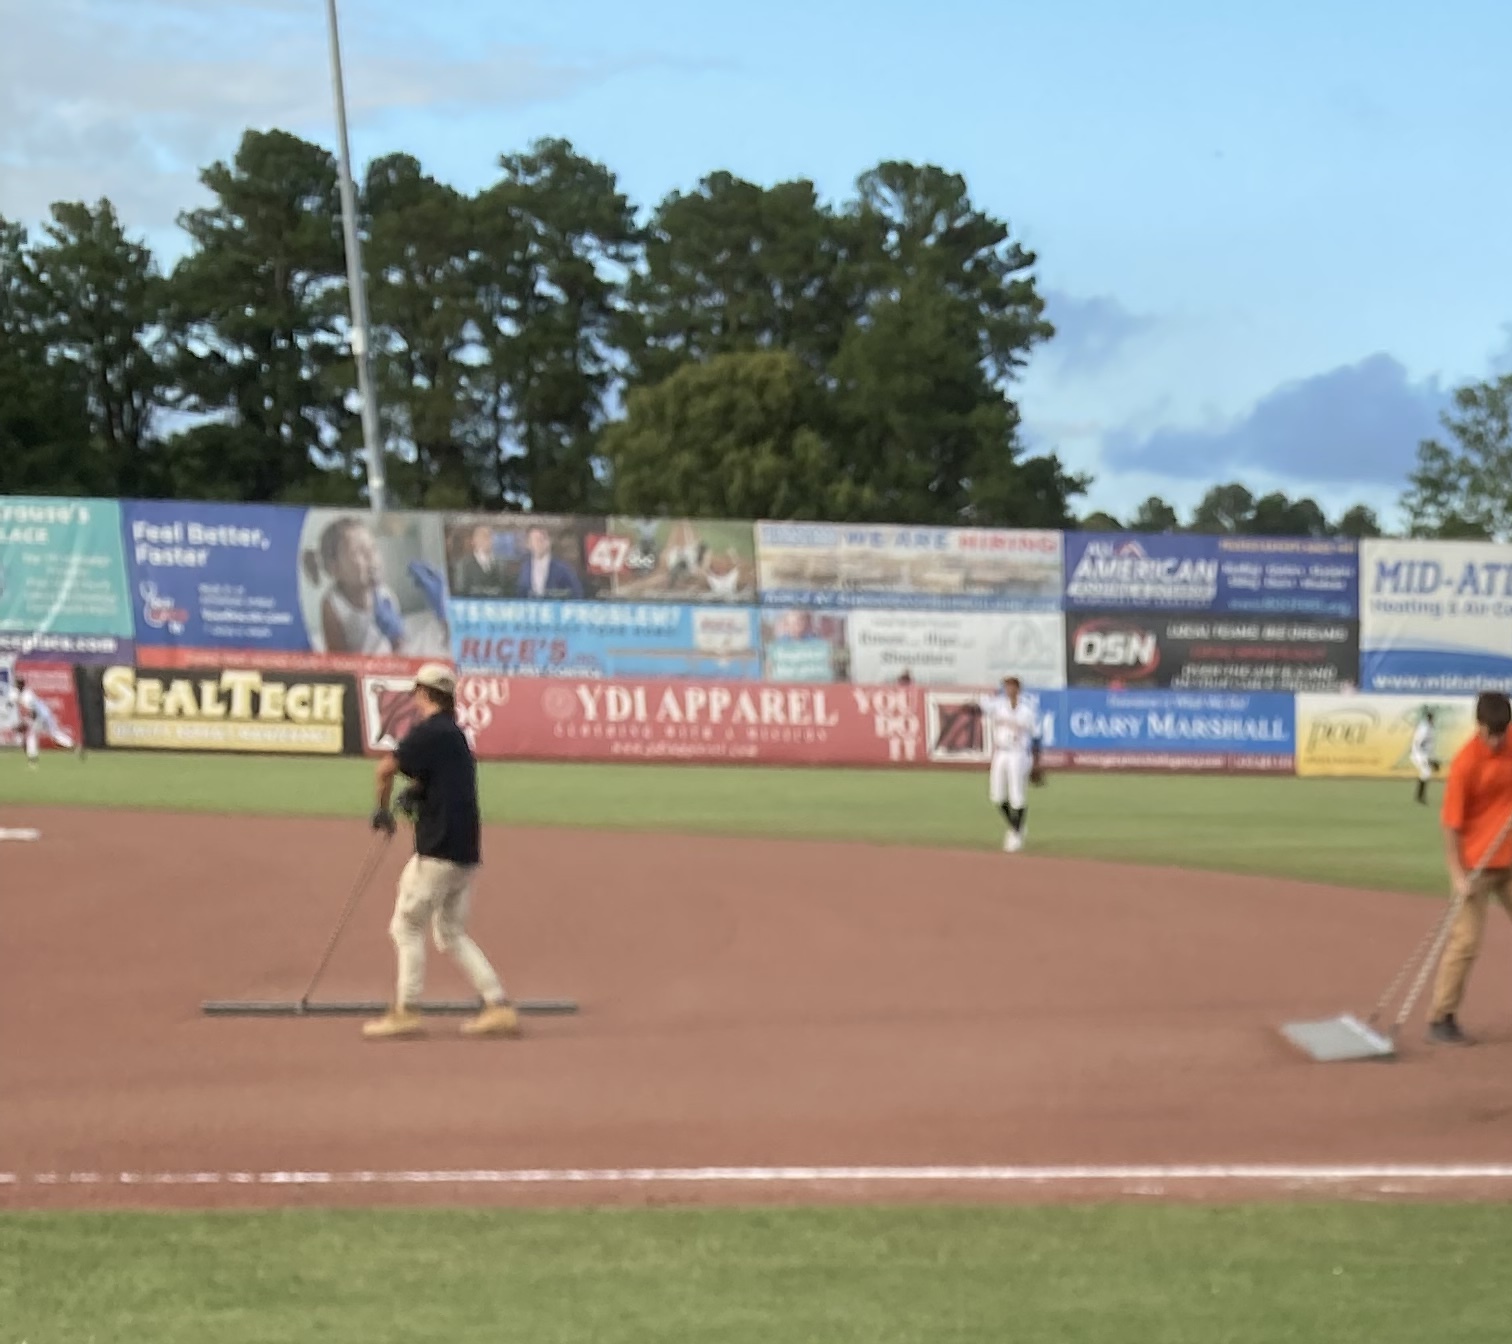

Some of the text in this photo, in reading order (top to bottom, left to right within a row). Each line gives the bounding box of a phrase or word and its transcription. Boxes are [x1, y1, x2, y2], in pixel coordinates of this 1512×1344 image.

[133, 520, 271, 550] Feel Better,
[957, 533, 1058, 554] HIRING
[135, 543, 210, 567] Faster
[588, 535, 630, 573] 47
[1074, 557, 1218, 584] AMERICAN
[460, 637, 568, 664] RICE'S
[1073, 630, 1157, 666] DSN
[456, 677, 511, 706] OU
[576, 683, 840, 727] YDI APPAREL
[852, 686, 913, 715] YOU
[874, 712, 920, 739] DO
[1069, 710, 1143, 739] GARY
[1147, 710, 1290, 742] MARSHALL
[889, 736, 917, 762] IT
